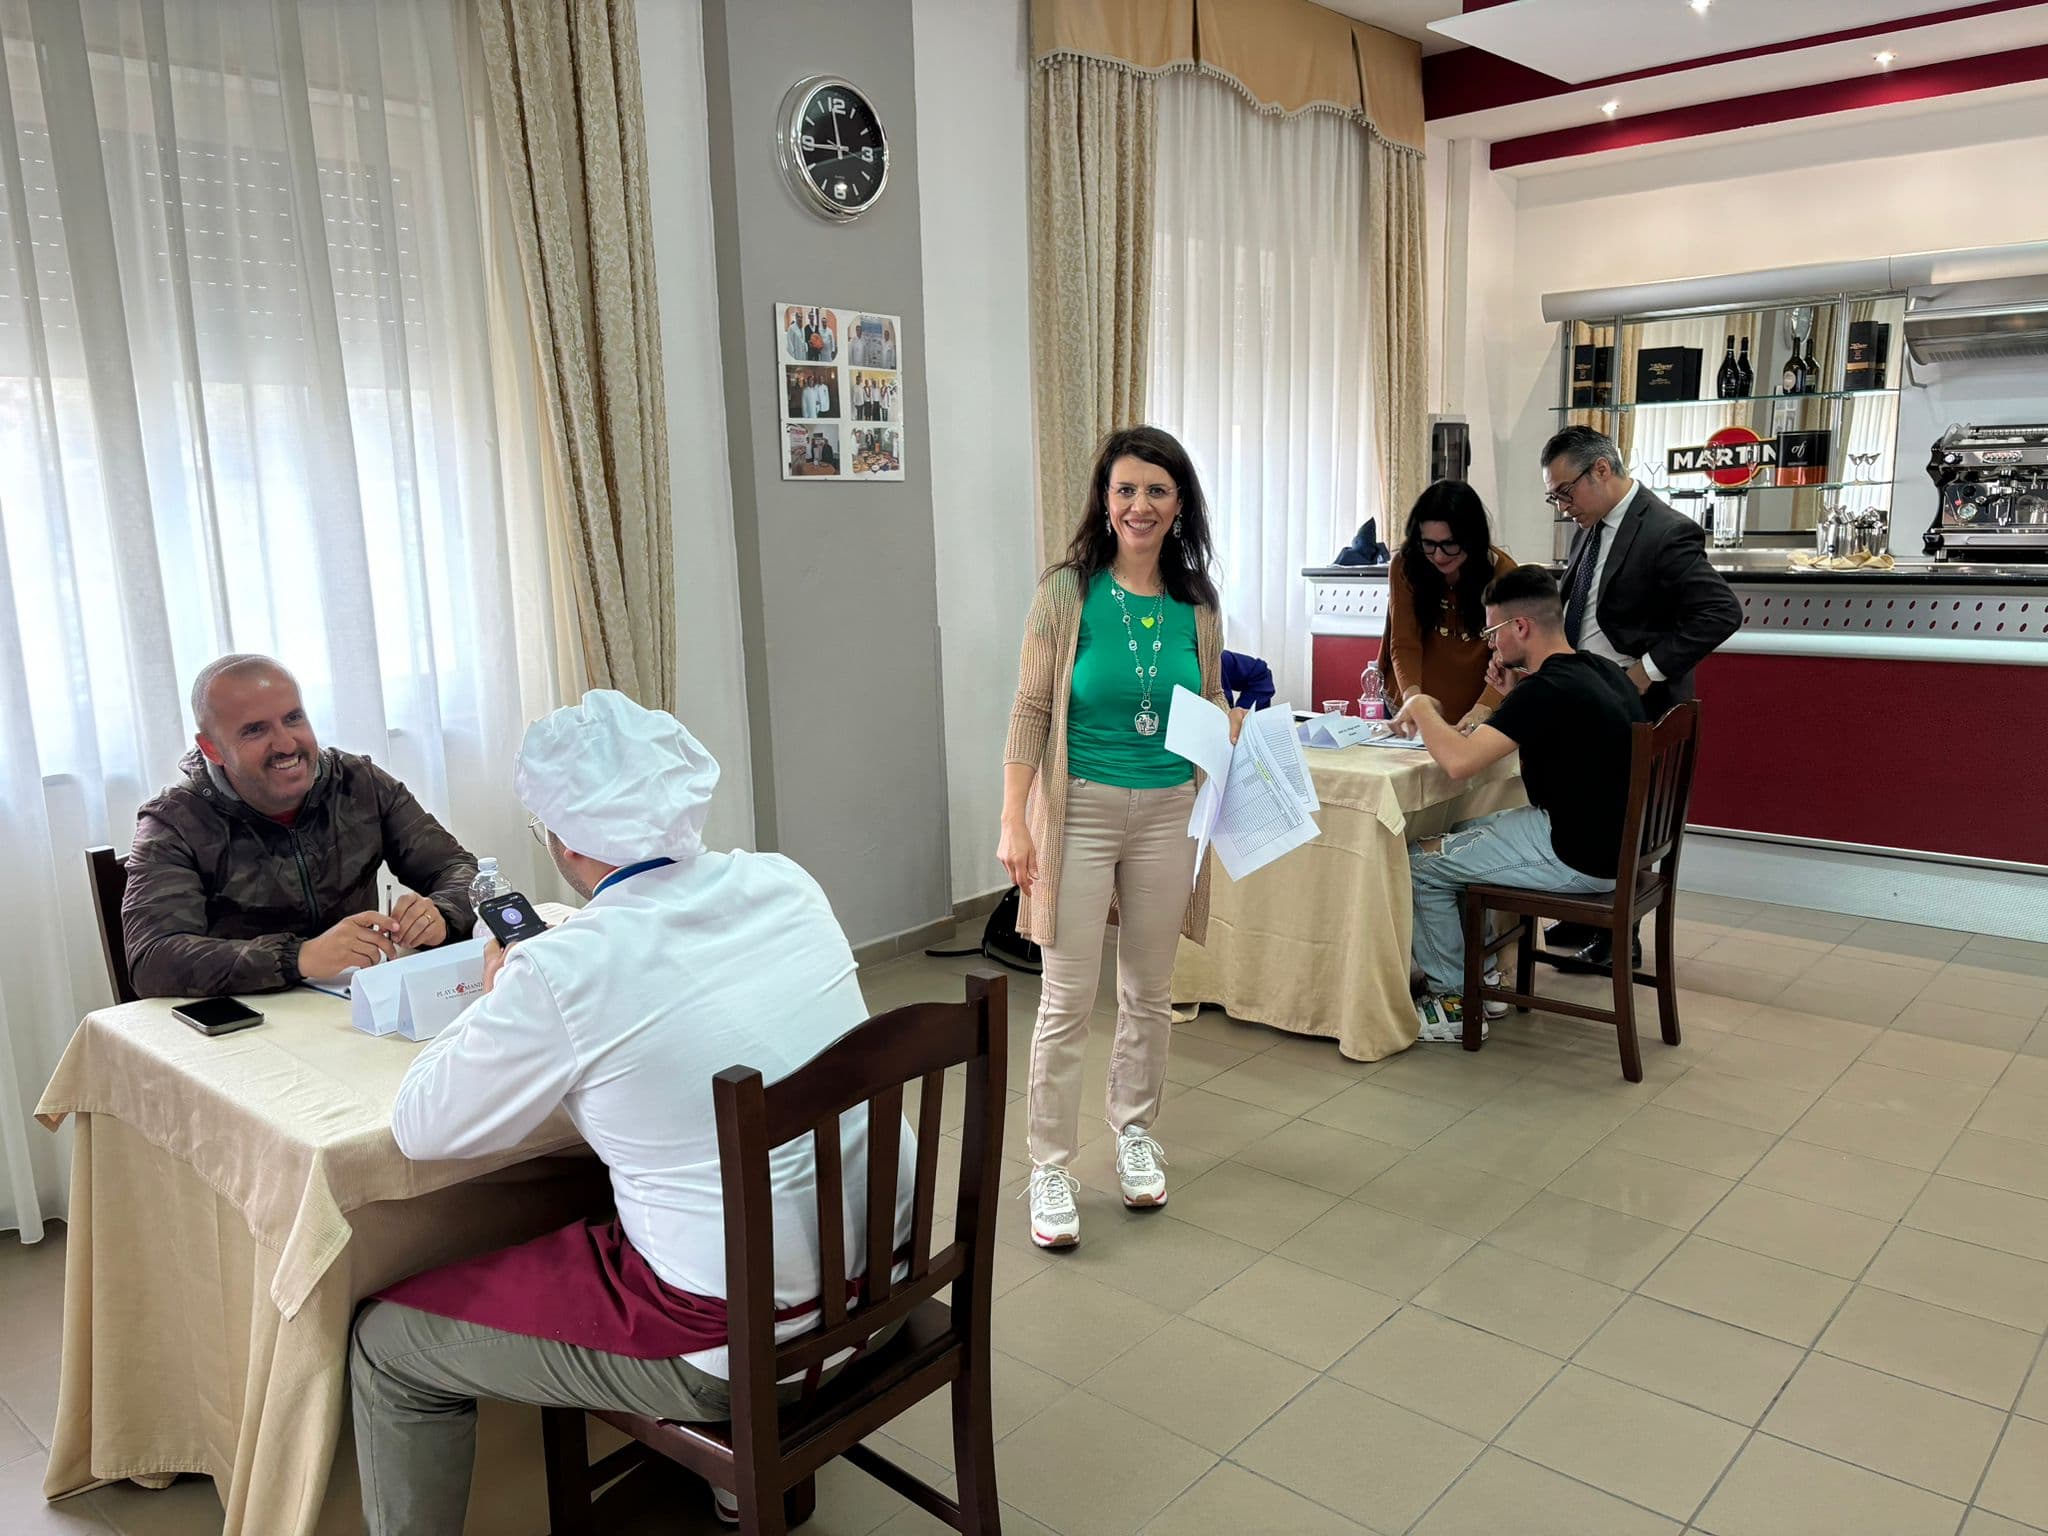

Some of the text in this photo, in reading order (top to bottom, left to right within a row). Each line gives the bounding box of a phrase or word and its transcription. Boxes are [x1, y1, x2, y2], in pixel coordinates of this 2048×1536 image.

[827, 96, 846, 115] 12
[802, 135, 815, 151] 9
[861, 146, 874, 163] 3
[834, 181, 847, 200] 6
[1673, 444, 1777, 470] MARTIN
